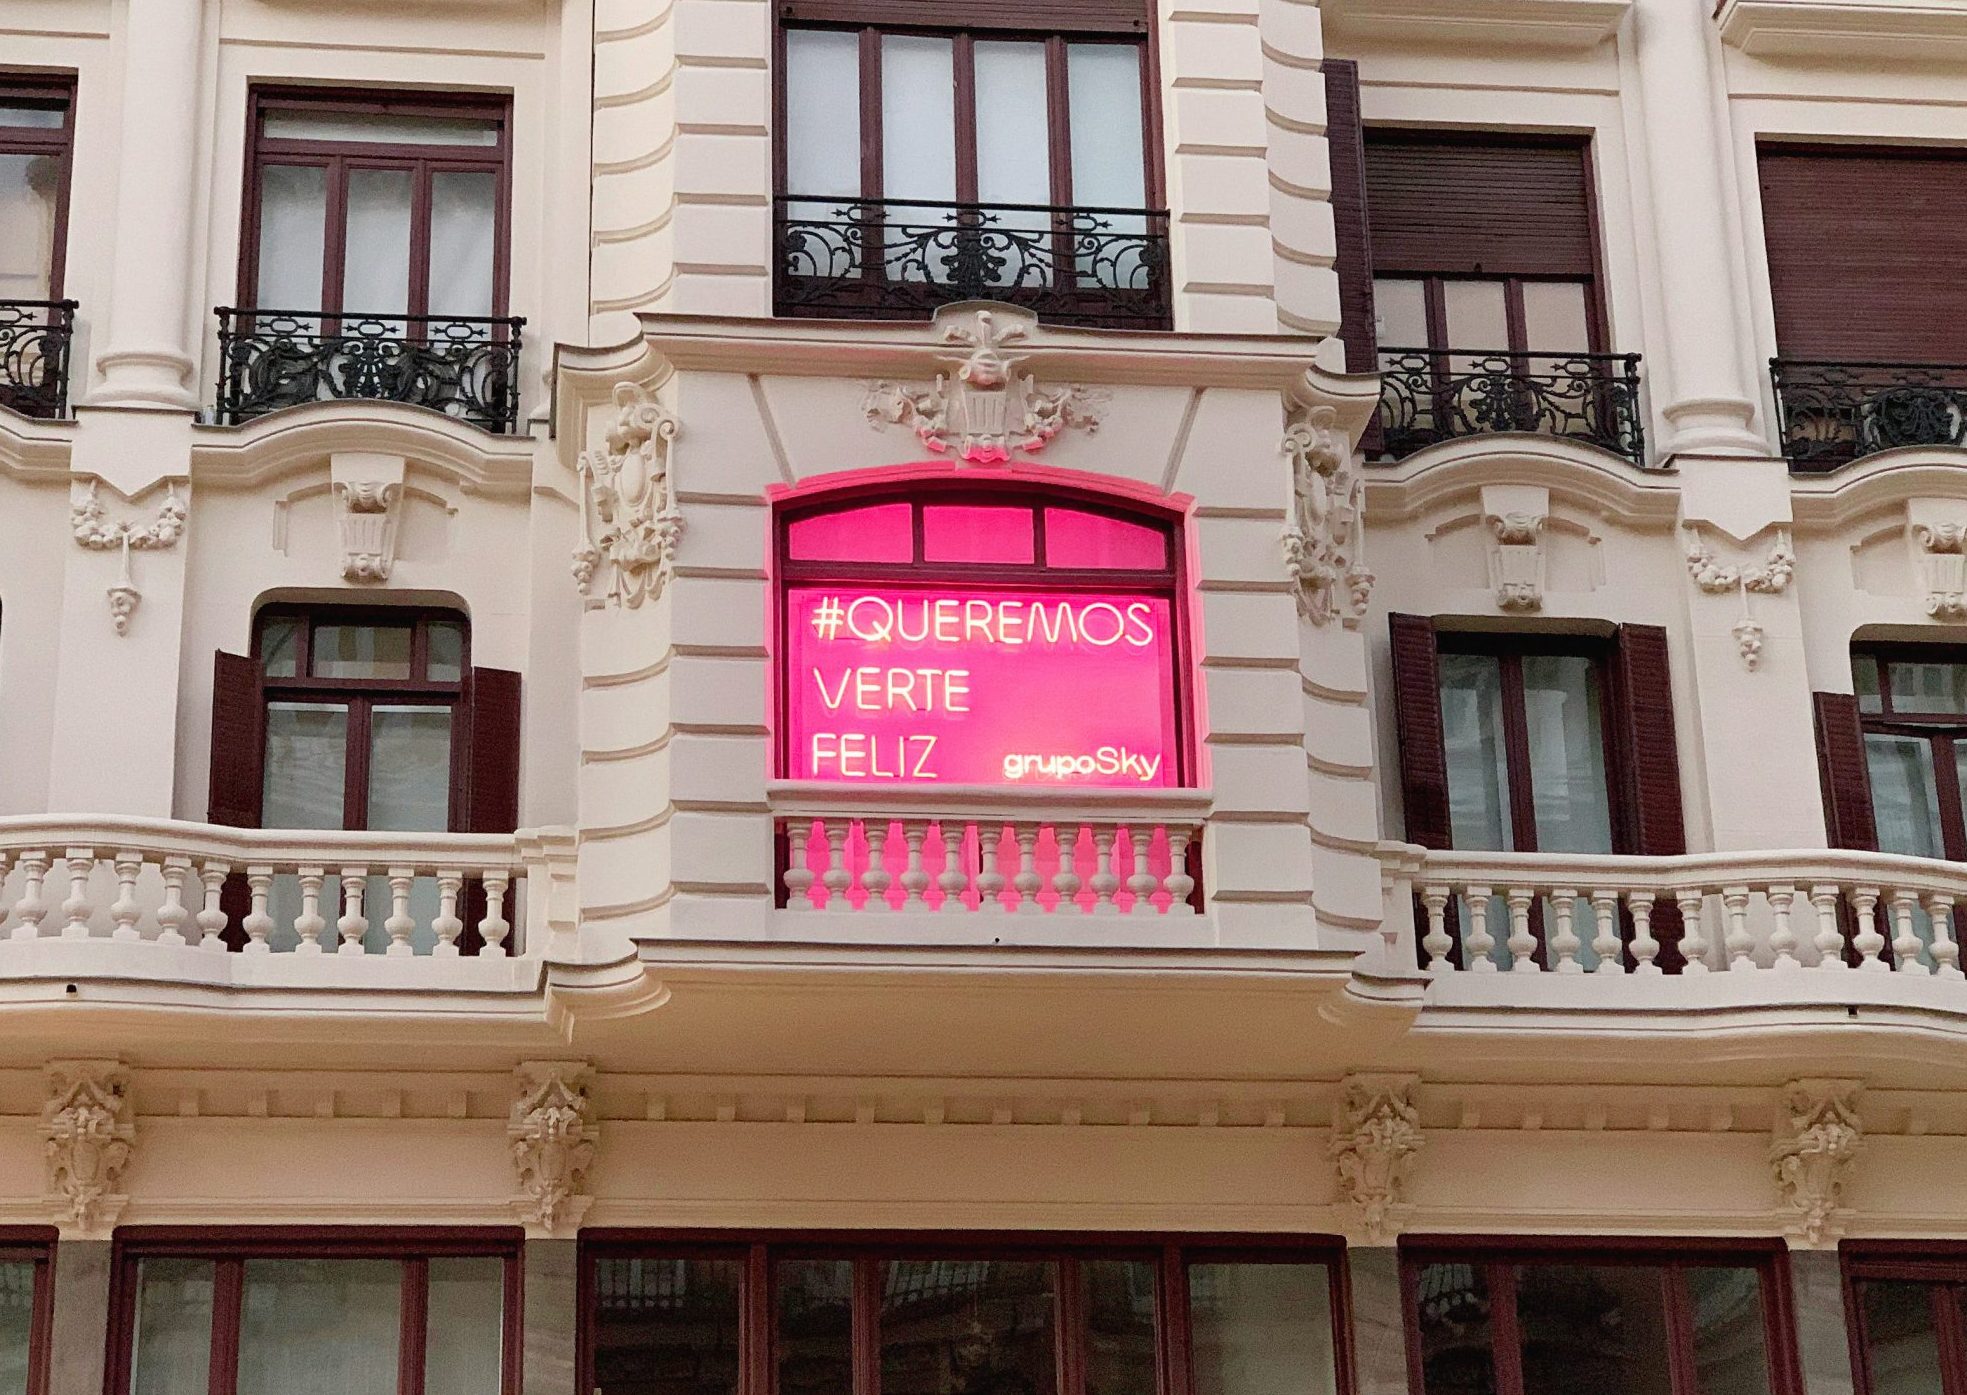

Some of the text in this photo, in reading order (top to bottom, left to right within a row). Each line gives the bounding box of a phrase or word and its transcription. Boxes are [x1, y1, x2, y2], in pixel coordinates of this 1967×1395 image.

[811, 596, 1153, 646] #QUEREMOS
[813, 667, 970, 712] VERTE
[812, 733, 938, 778] FELIZ
[1003, 746, 1161, 781] grupoSky
